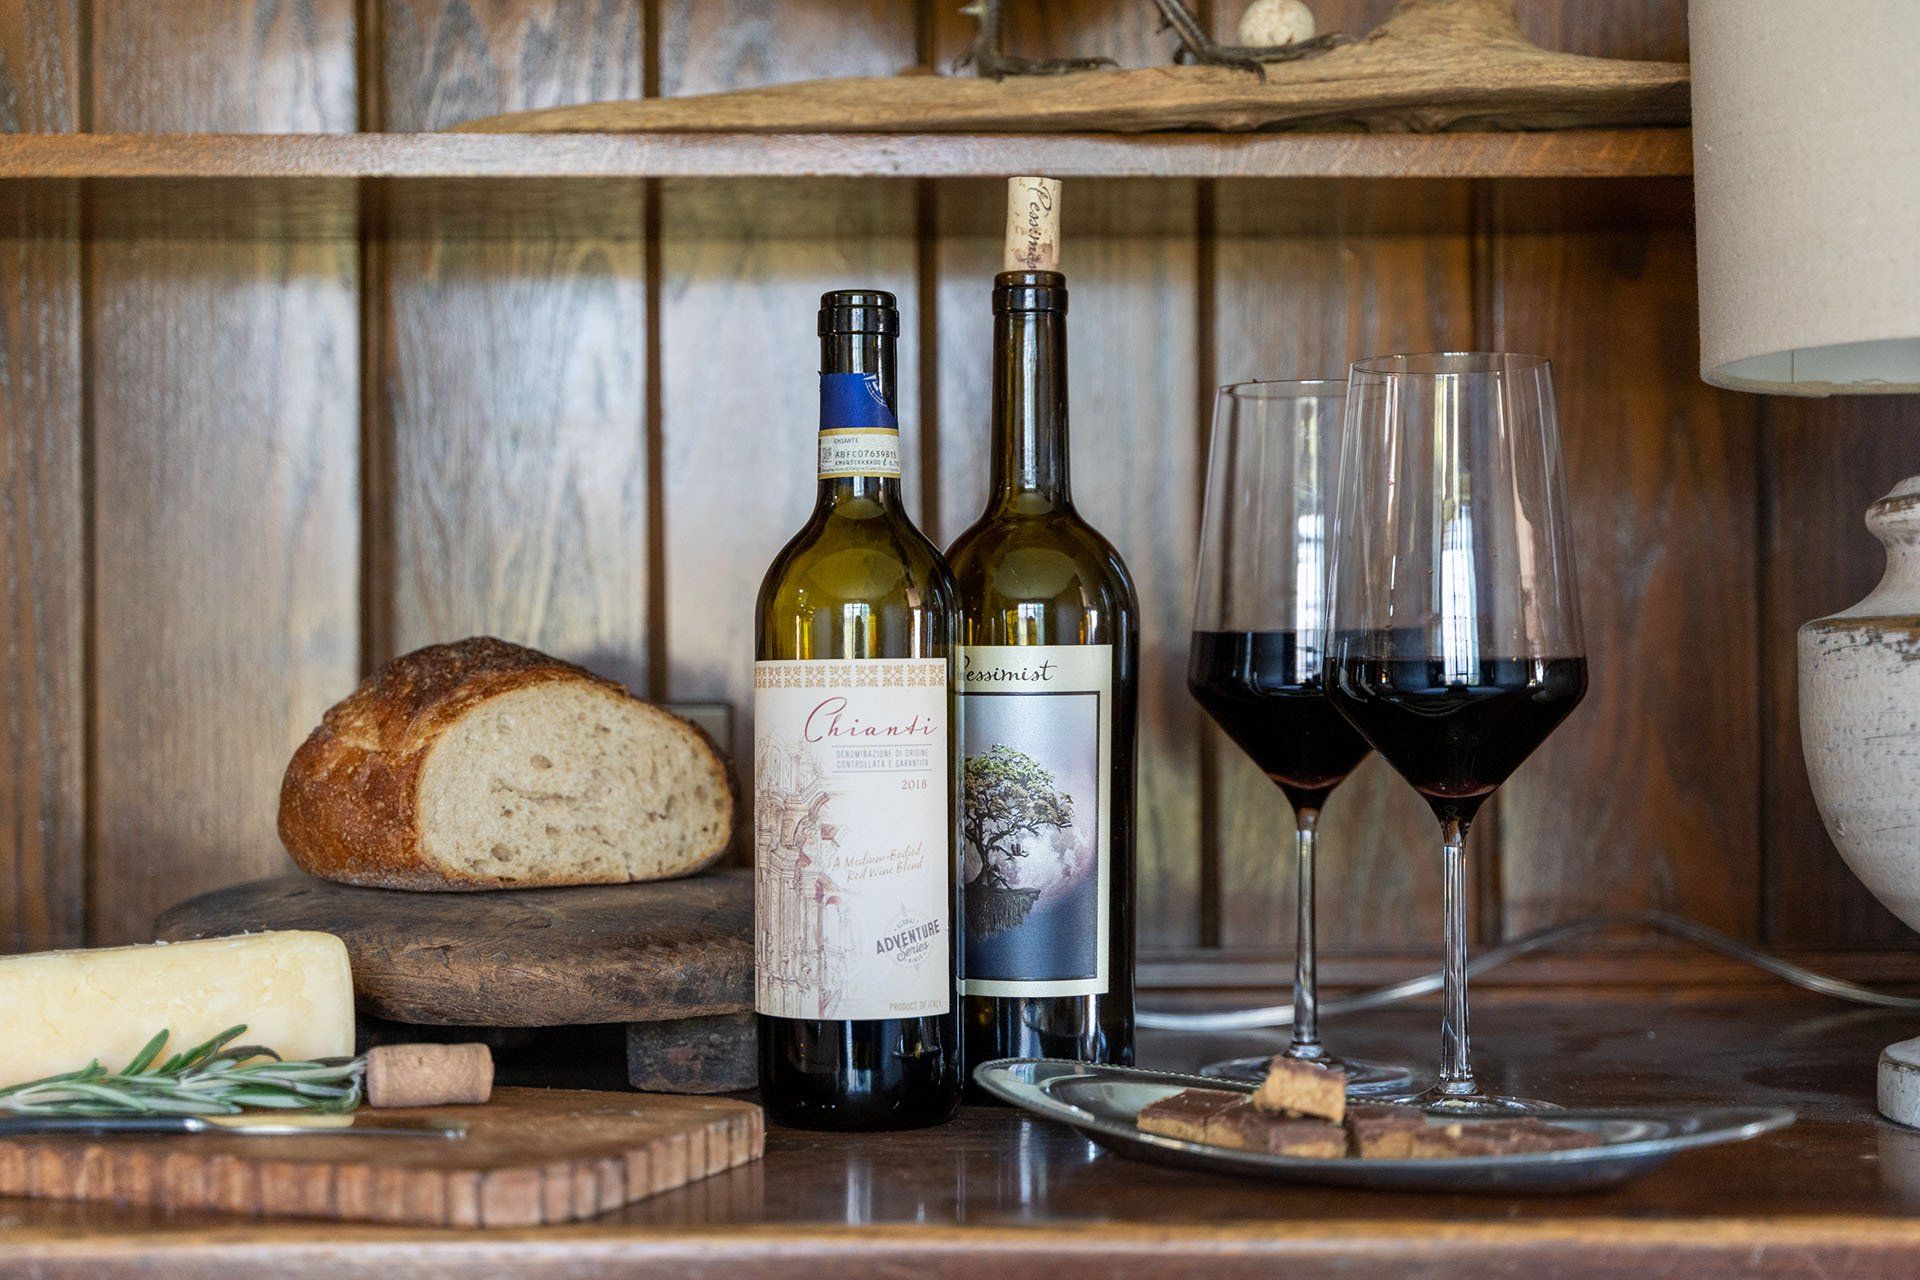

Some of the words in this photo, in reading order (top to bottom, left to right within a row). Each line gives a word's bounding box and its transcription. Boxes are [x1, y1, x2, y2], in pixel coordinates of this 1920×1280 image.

[804, 696, 938, 743] Chianti
[836, 748, 892, 759] DENOMINAZIONE
[895, 748, 903, 757] DI
[836, 759, 886, 769] CONTROLLATA
[895, 759, 929, 768] GARANTITA
[901, 779, 928, 790] 2018
[846, 864, 867, 882] Red
[869, 864, 894, 878] Wine
[876, 919, 941, 955] ADVENTURE
[896, 941, 929, 962] Series
